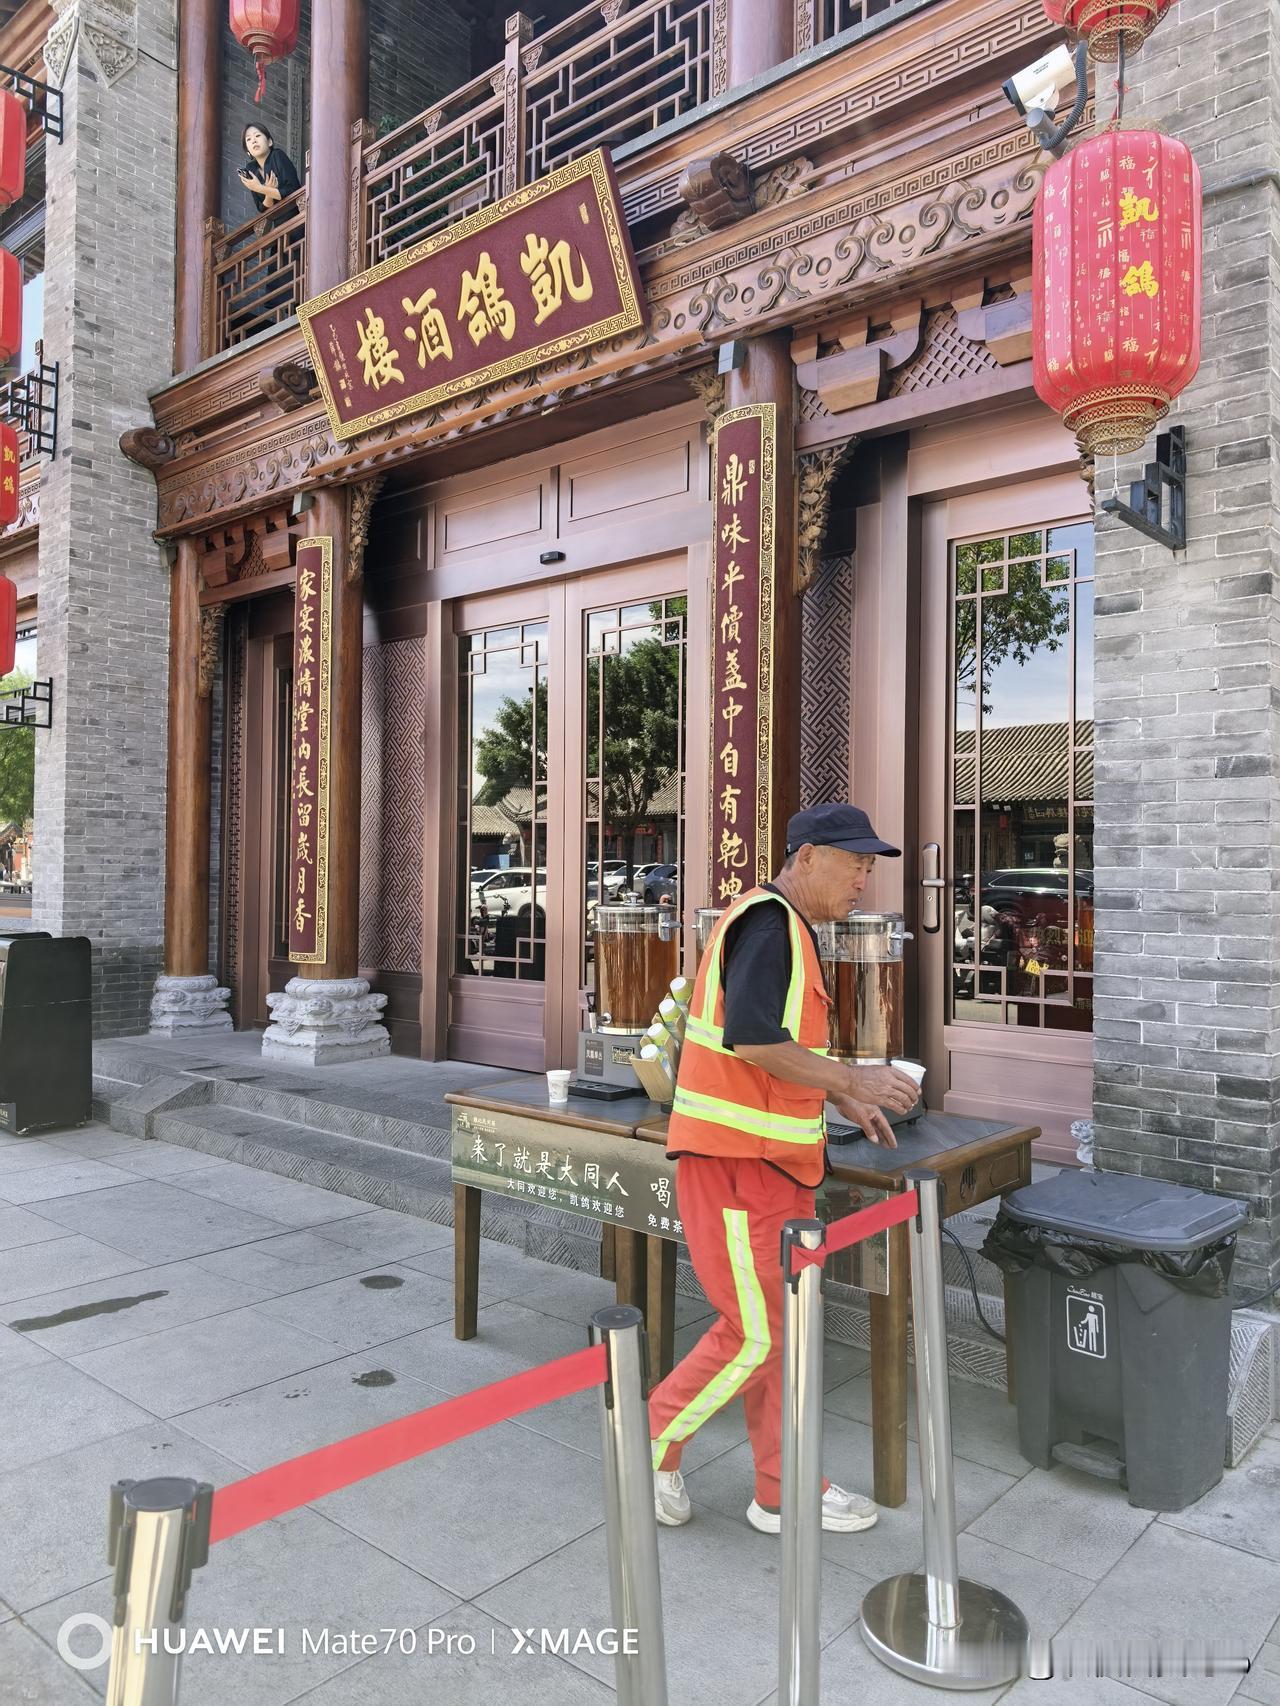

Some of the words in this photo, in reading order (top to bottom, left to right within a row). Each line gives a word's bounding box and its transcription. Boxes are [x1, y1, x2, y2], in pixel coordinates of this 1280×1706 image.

[470, 1134, 629, 1197] 来了就是大同人
[650, 1177, 671, 1209] 喝
